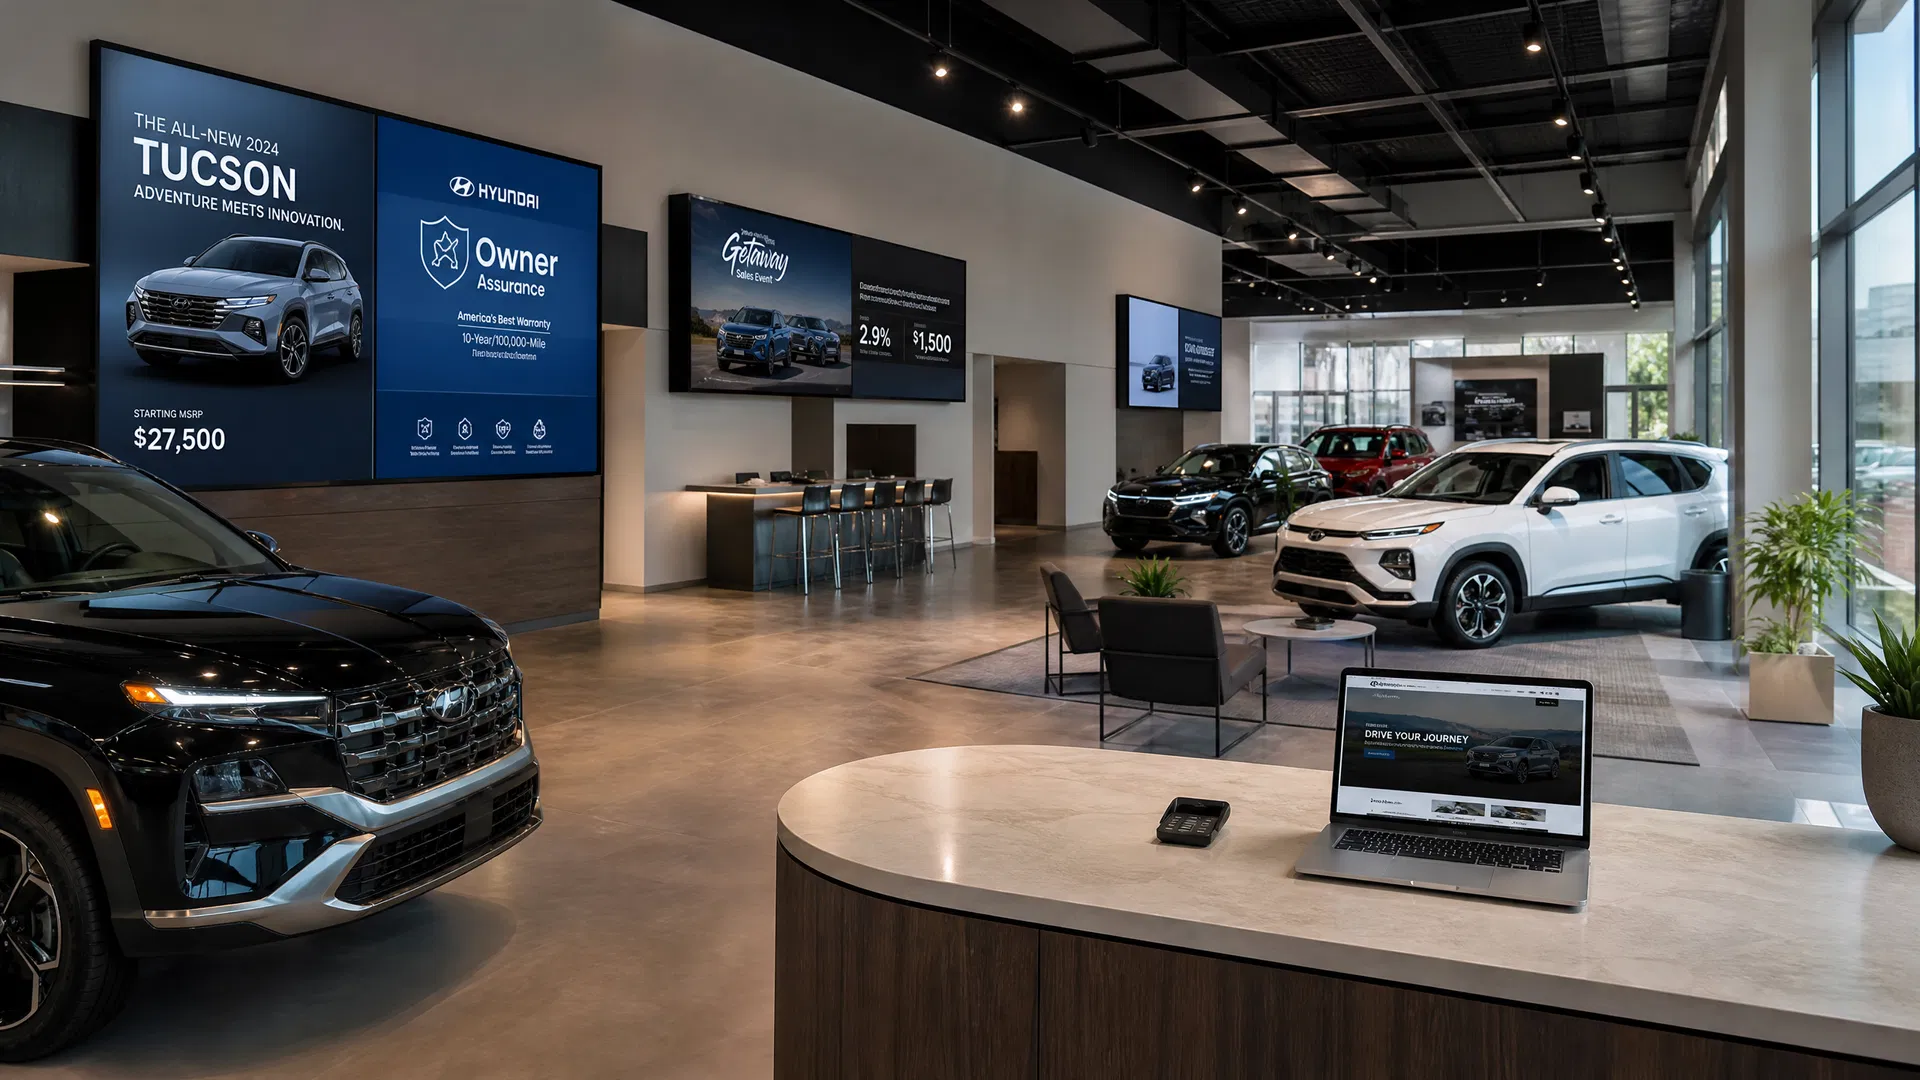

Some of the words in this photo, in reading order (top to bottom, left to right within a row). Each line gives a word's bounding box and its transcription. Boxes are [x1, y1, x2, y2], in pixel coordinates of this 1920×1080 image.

[134, 112, 166, 134] THE
[171, 121, 241, 148] ALL-NEW
[247, 136, 279, 156] 2024
[133, 136, 296, 202] TUCSON
[134, 184, 218, 211] ADVENTURE
[222, 199, 264, 218] MEETS
[268, 207, 345, 232] INNOVATION.
[478, 183, 539, 210] HYUNDAI
[475, 236, 559, 277] Owner
[721, 231, 789, 282] Getaway
[477, 274, 545, 297] Assurance
[736, 268, 754, 281] Sales
[755, 272, 773, 284] Event
[457, 310, 497, 324] America's
[498, 314, 515, 326] Best
[517, 316, 551, 330] Warranty
[462, 332, 546, 349] 10-Year/100,000-Mile
[859, 323, 891, 347] 2.9%
[913, 330, 952, 354] $1,500
[133, 408, 177, 418] STARTING
[179, 409, 204, 419] MSRP
[133, 425, 226, 455] $27,500
[1364, 729, 1393, 740] DRIVE
[1395, 731, 1421, 741] YOUR
[1423, 733, 1469, 744] JOURNEY
